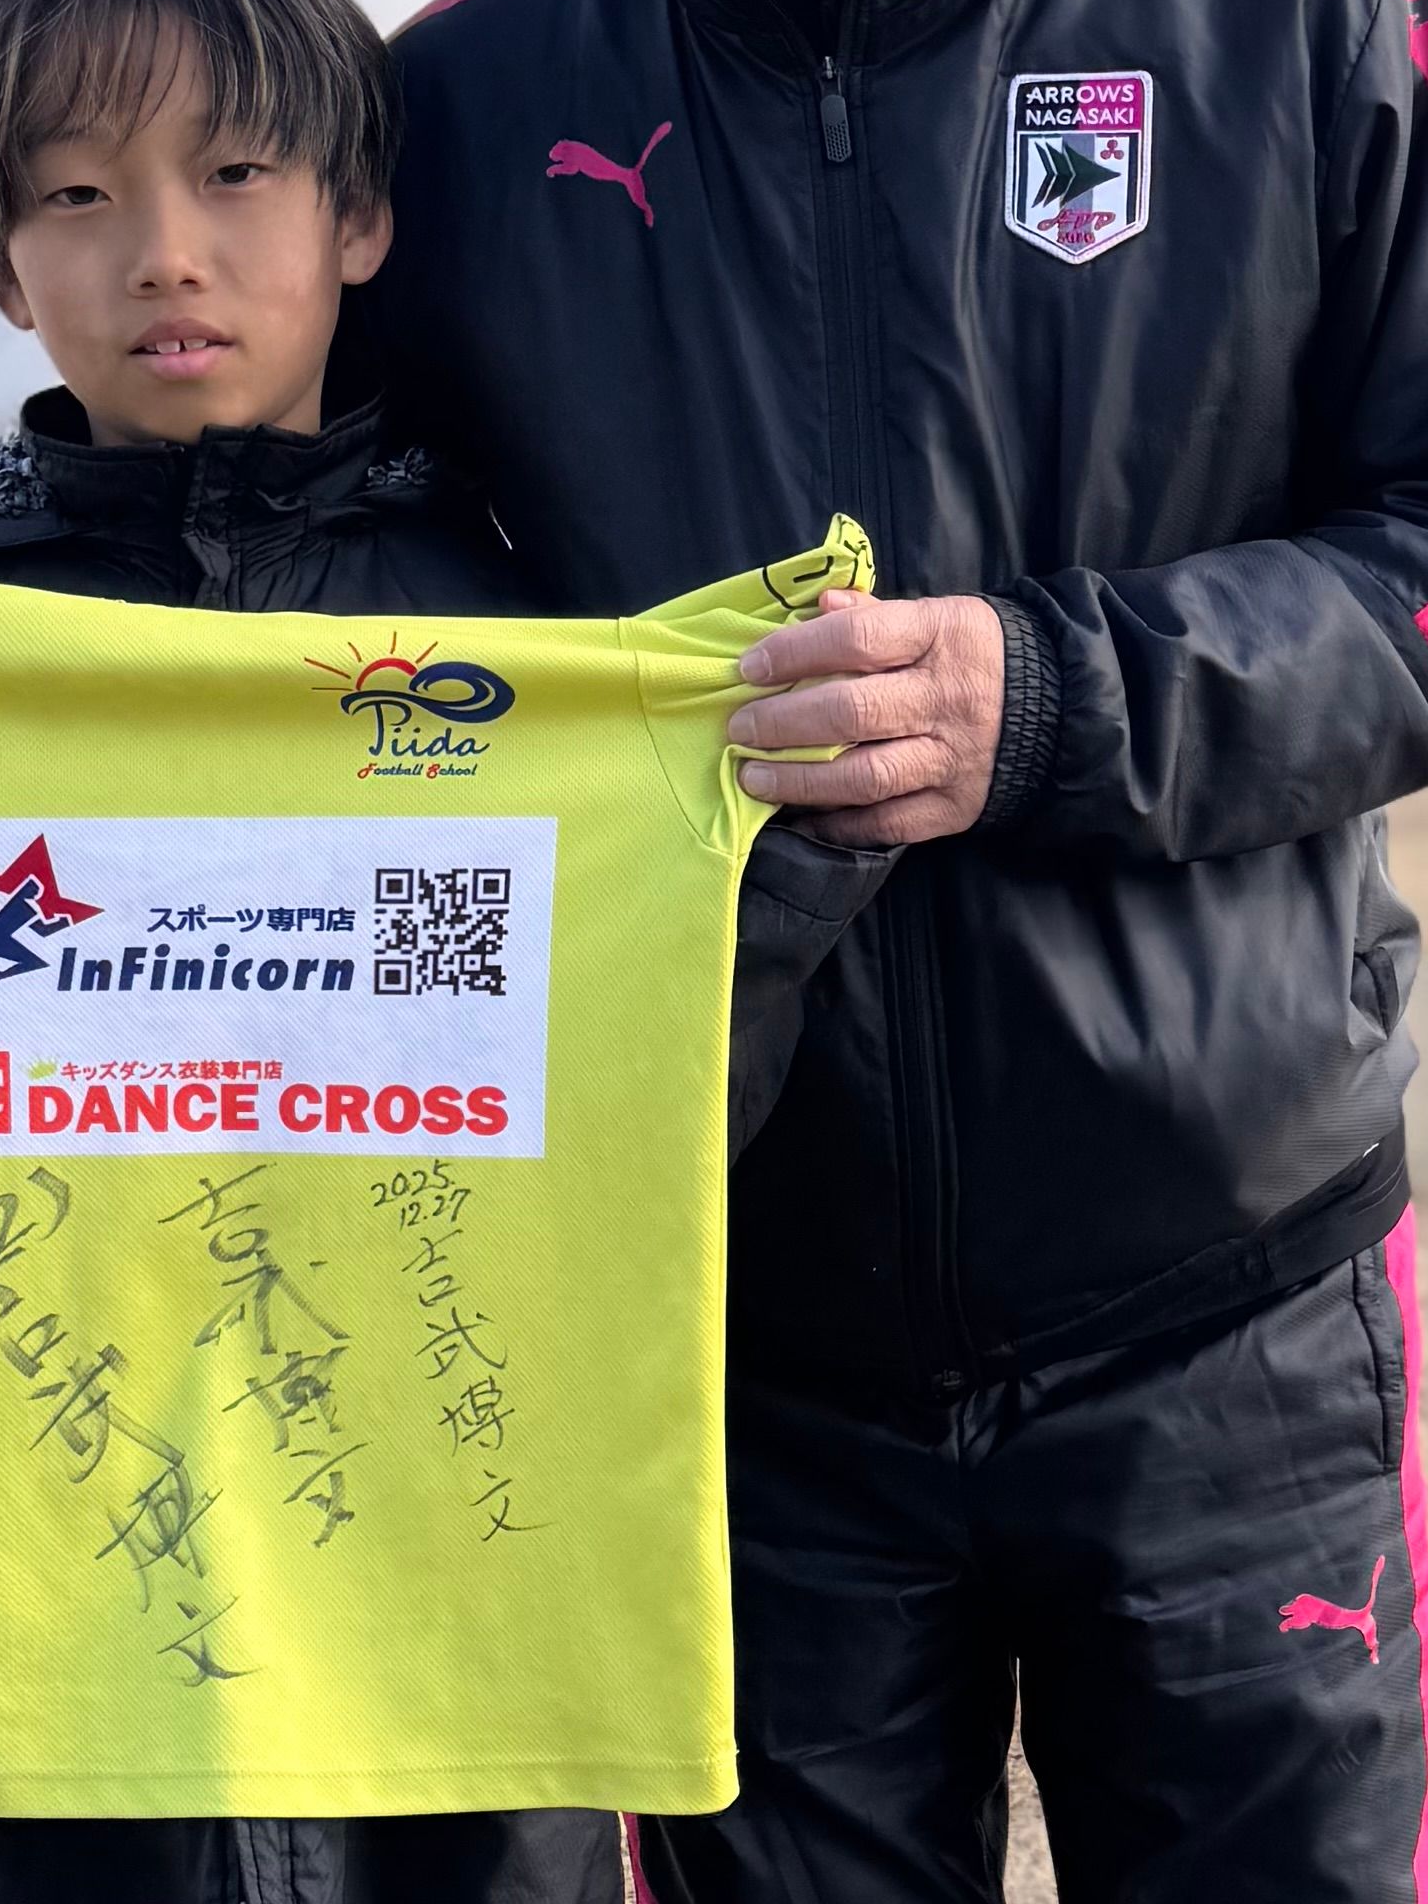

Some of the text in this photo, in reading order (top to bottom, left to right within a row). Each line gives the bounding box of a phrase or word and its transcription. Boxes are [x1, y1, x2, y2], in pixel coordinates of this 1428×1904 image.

[1025, 84, 1135, 105] ARROWS
[1025, 107, 1134, 127] NAGASAKI
[352, 700, 490, 756] Piida
[357, 762, 478, 779] Football School
[146, 904, 356, 933] スポーツ専門店
[60, 1060, 284, 1081] キッズダンス衣装専門店
[28, 1083, 510, 1136] DANCE CROSS
[402, 1229, 557, 1541] 吉武博文
